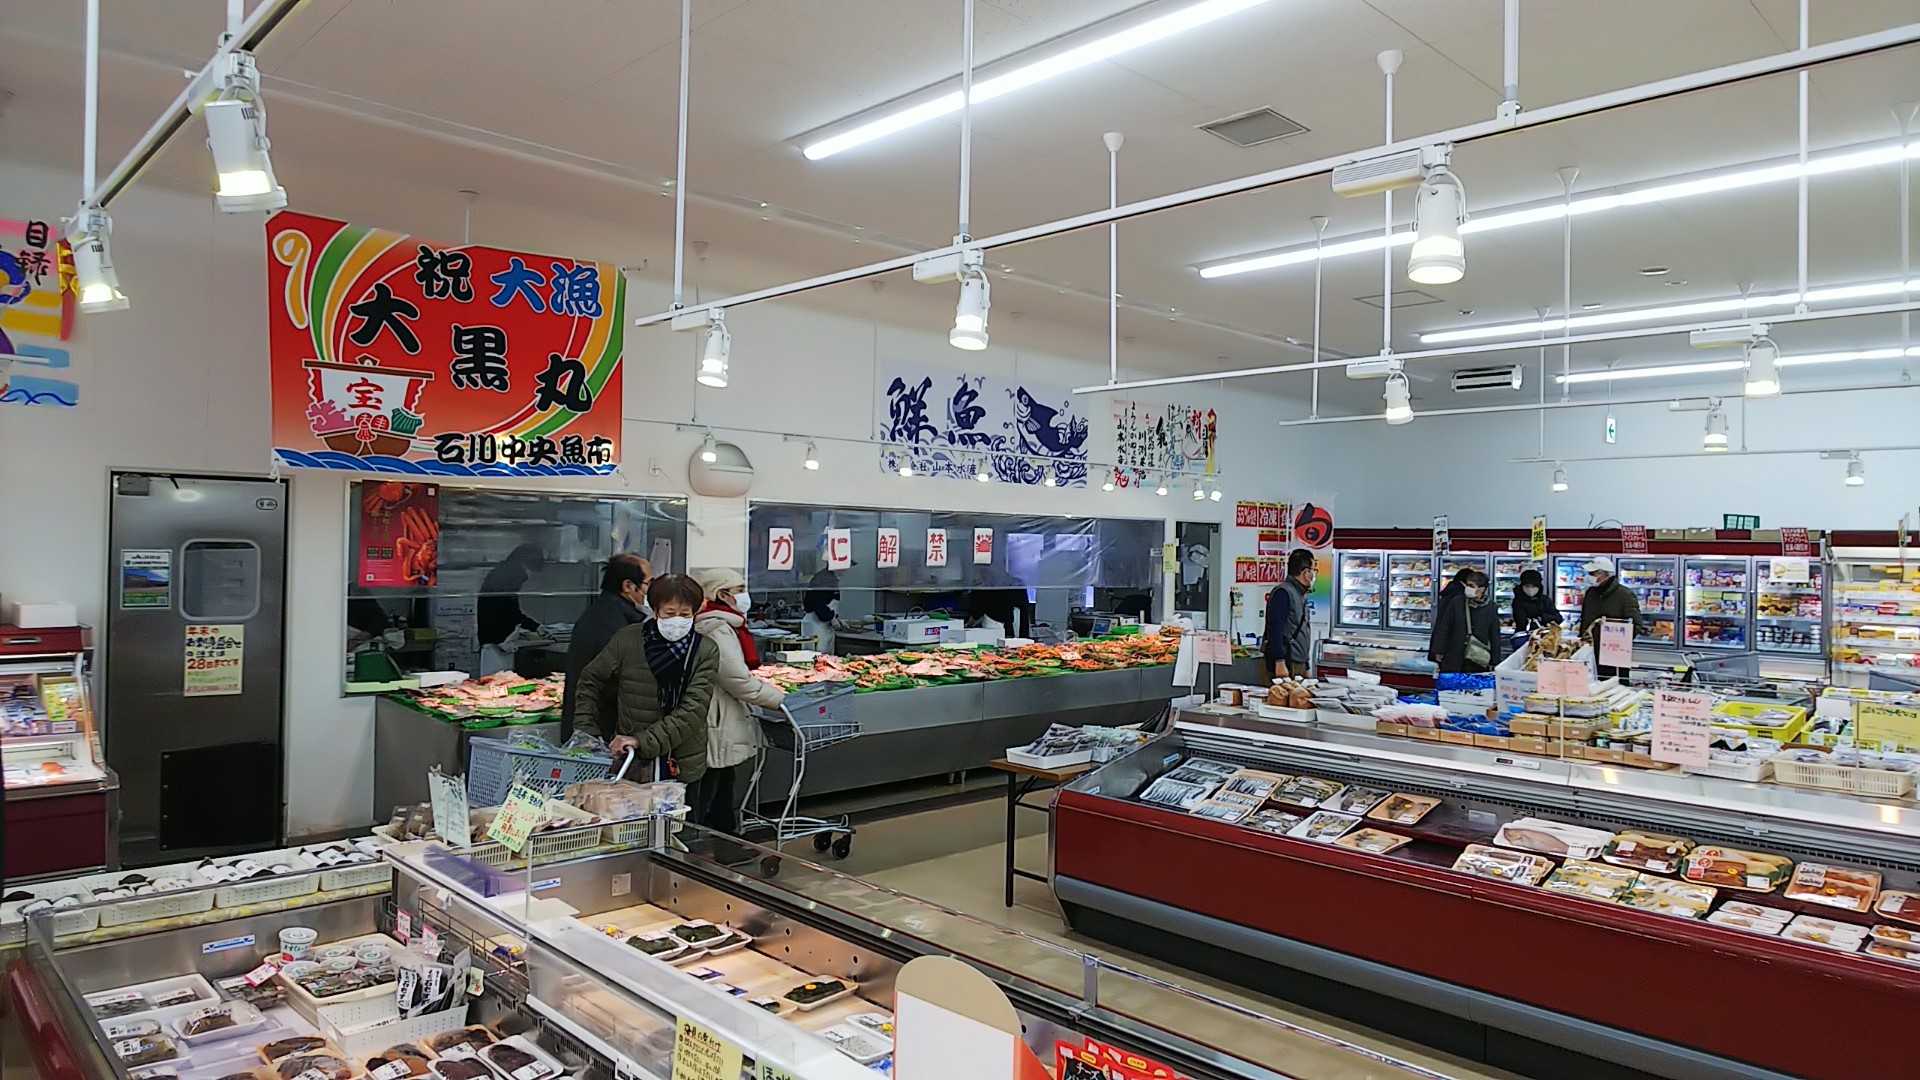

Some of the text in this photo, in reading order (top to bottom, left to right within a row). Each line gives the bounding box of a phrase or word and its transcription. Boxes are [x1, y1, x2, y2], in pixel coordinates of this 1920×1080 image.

[15, 220, 51, 286] 目録
[414, 245, 604, 319] 祝 大漁
[345, 377, 385, 411] 宝
[886, 375, 992, 456] 鮮魚
[433, 433, 614, 466] 石川中央魚市
